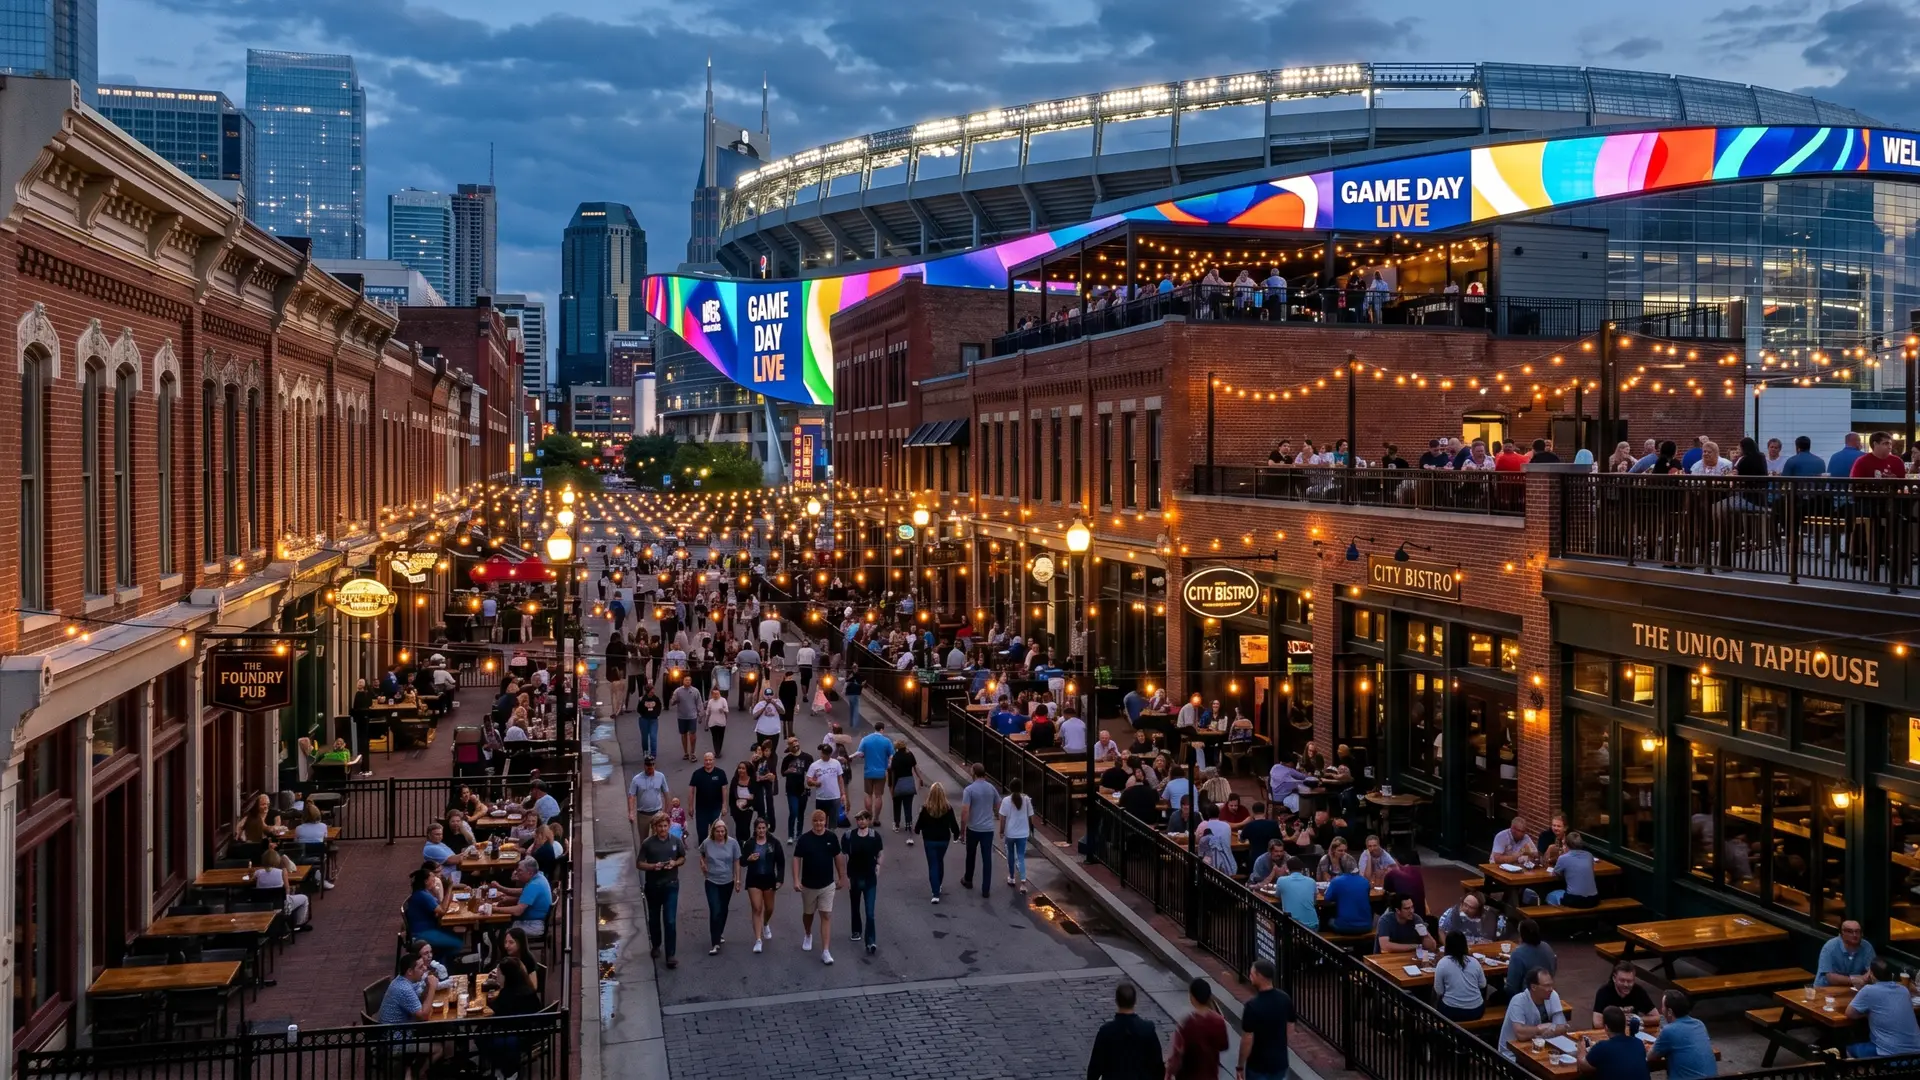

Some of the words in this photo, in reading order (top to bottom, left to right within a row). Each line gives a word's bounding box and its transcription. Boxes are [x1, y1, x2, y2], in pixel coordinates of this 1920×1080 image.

[1882, 136, 1920, 167] WEL
[1341, 178, 1411, 203] GAME
[1416, 176, 1464, 201] DAY
[1376, 204, 1430, 228] LIVE
[747, 290, 789, 322] GAME
[754, 322, 783, 352] DAY
[753, 353, 786, 383] LIVE
[1373, 564, 1402, 584] CITY
[1404, 568, 1453, 593] BISTRO
[1188, 585, 1213, 601] CITY
[1214, 585, 1254, 601] BISTRO
[242, 662, 262, 671] THE
[1632, 622, 1669, 651] THE
[1676, 629, 1743, 665] UNION
[1750, 642, 1880, 688] TAPHOUSE
[221, 671, 284, 685] FOUNDRY
[239, 685, 267, 698] PUB
